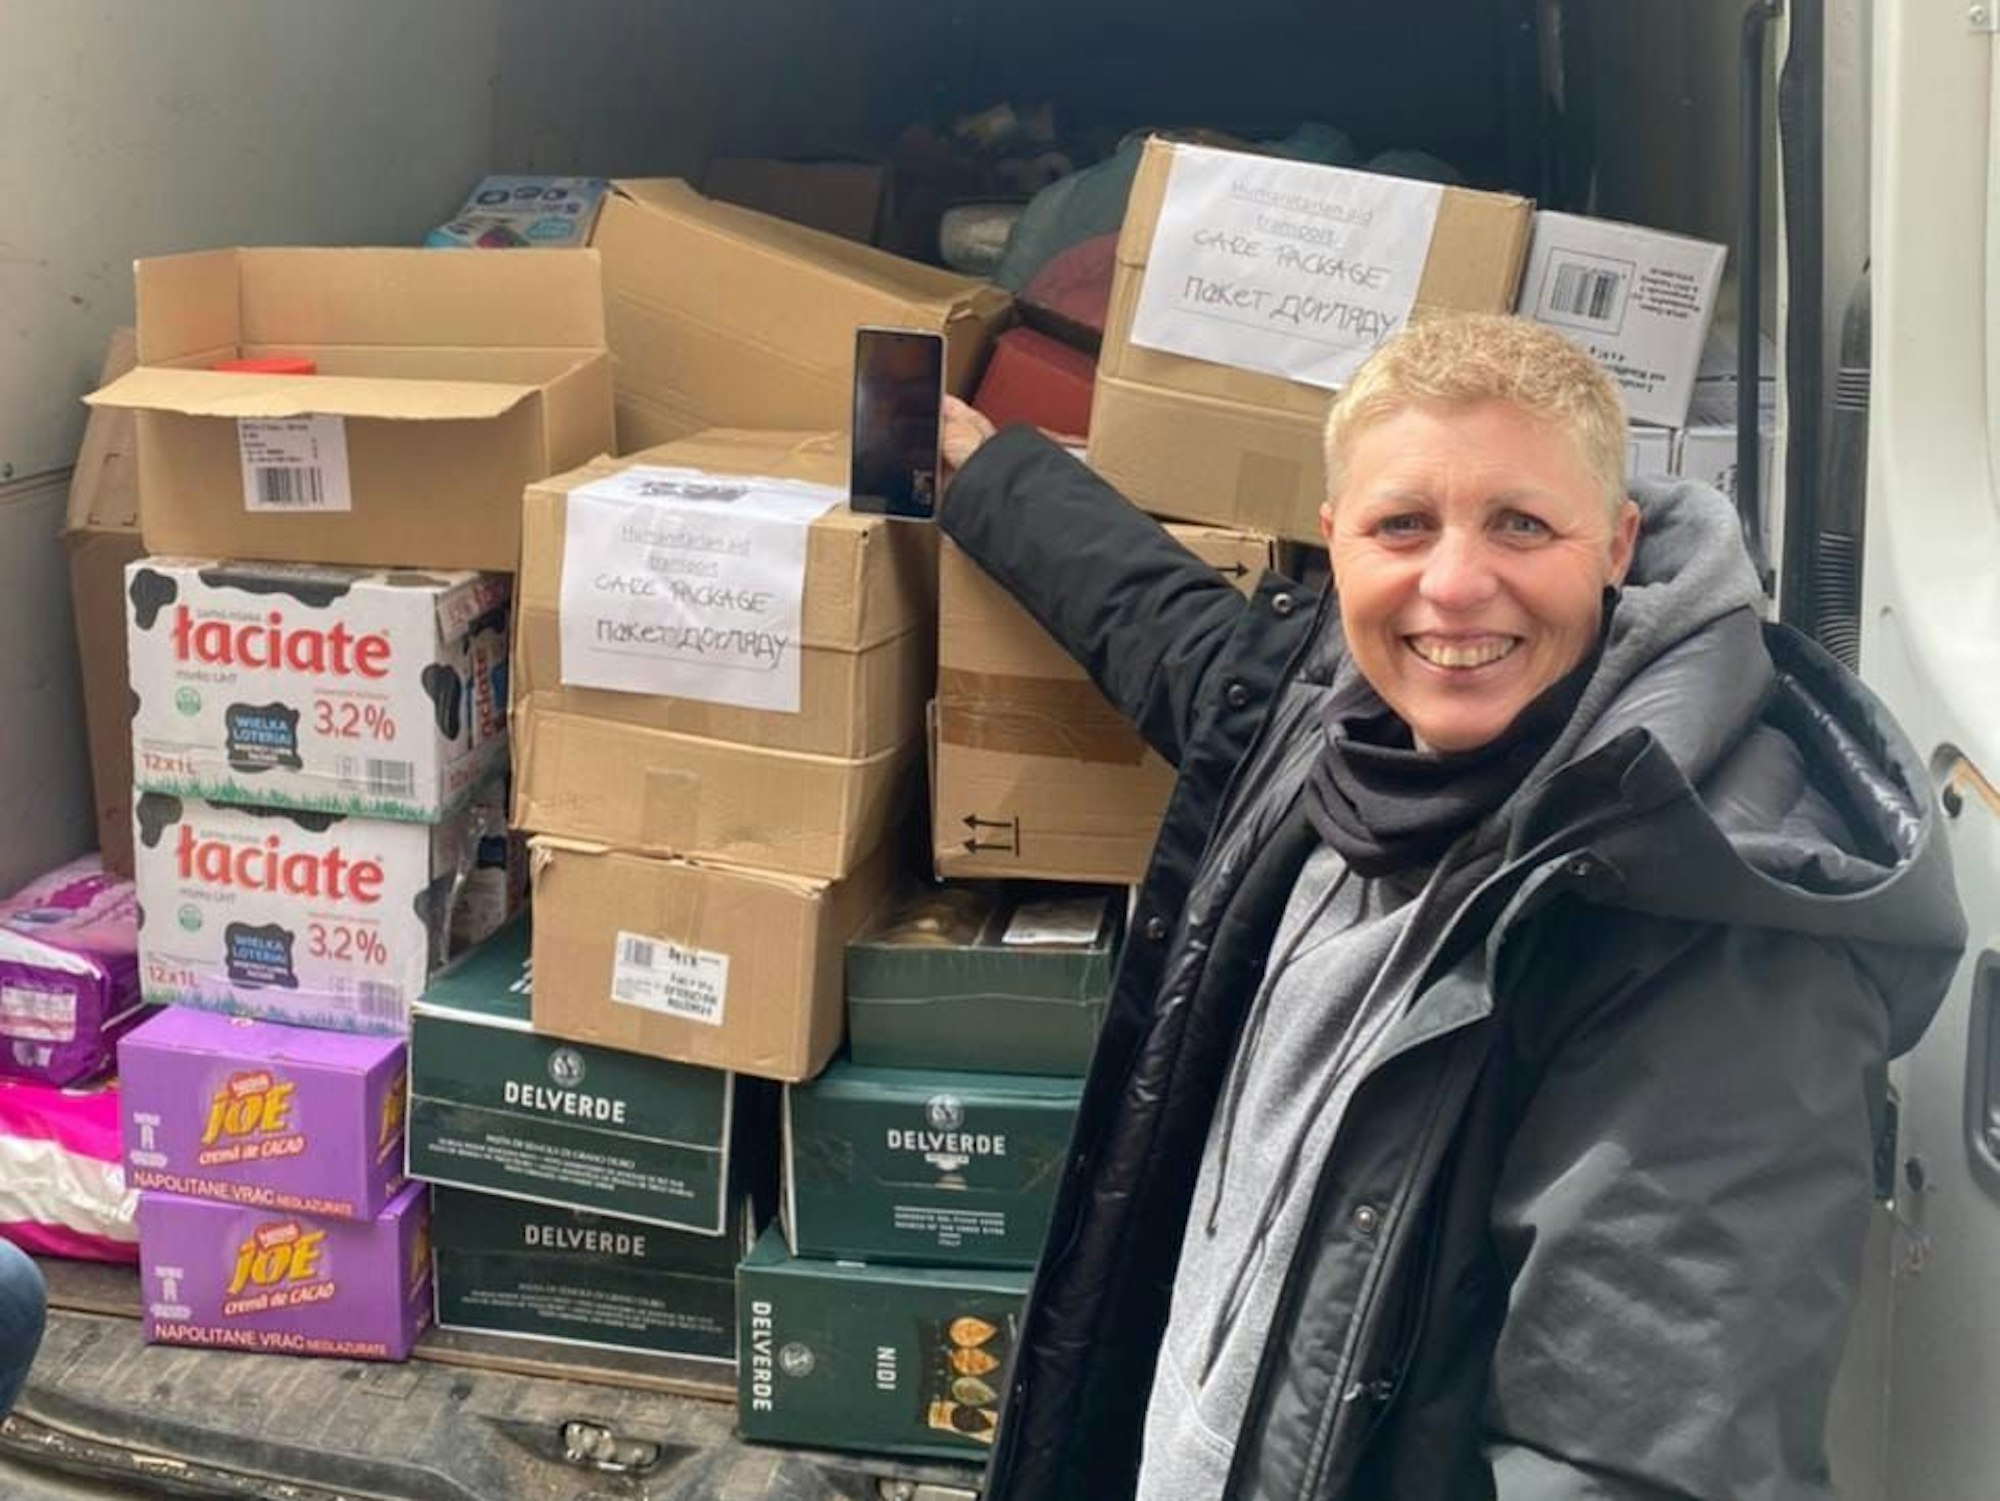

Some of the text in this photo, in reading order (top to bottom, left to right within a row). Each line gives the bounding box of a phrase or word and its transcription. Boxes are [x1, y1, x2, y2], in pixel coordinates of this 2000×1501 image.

[1192, 227, 1391, 289] CARE PACKAGE
[171, 604, 392, 680] łaciate
[174, 823, 385, 905] łaciate
[504, 1080, 628, 1125] DELVERDE
[886, 1128, 1006, 1155] DELVERDE
[132, 1171, 230, 1200] NAPOLITANE
[231, 1184, 277, 1205] VRAC
[524, 1224, 646, 1257] DELVERDE
[289, 1283, 336, 1306] CACAO
[155, 1323, 257, 1348] NAPOLITANE
[259, 1331, 305, 1351] VRAC
[751, 1300, 773, 1412] DELVERDE
[876, 1345, 898, 1391] NIDI
